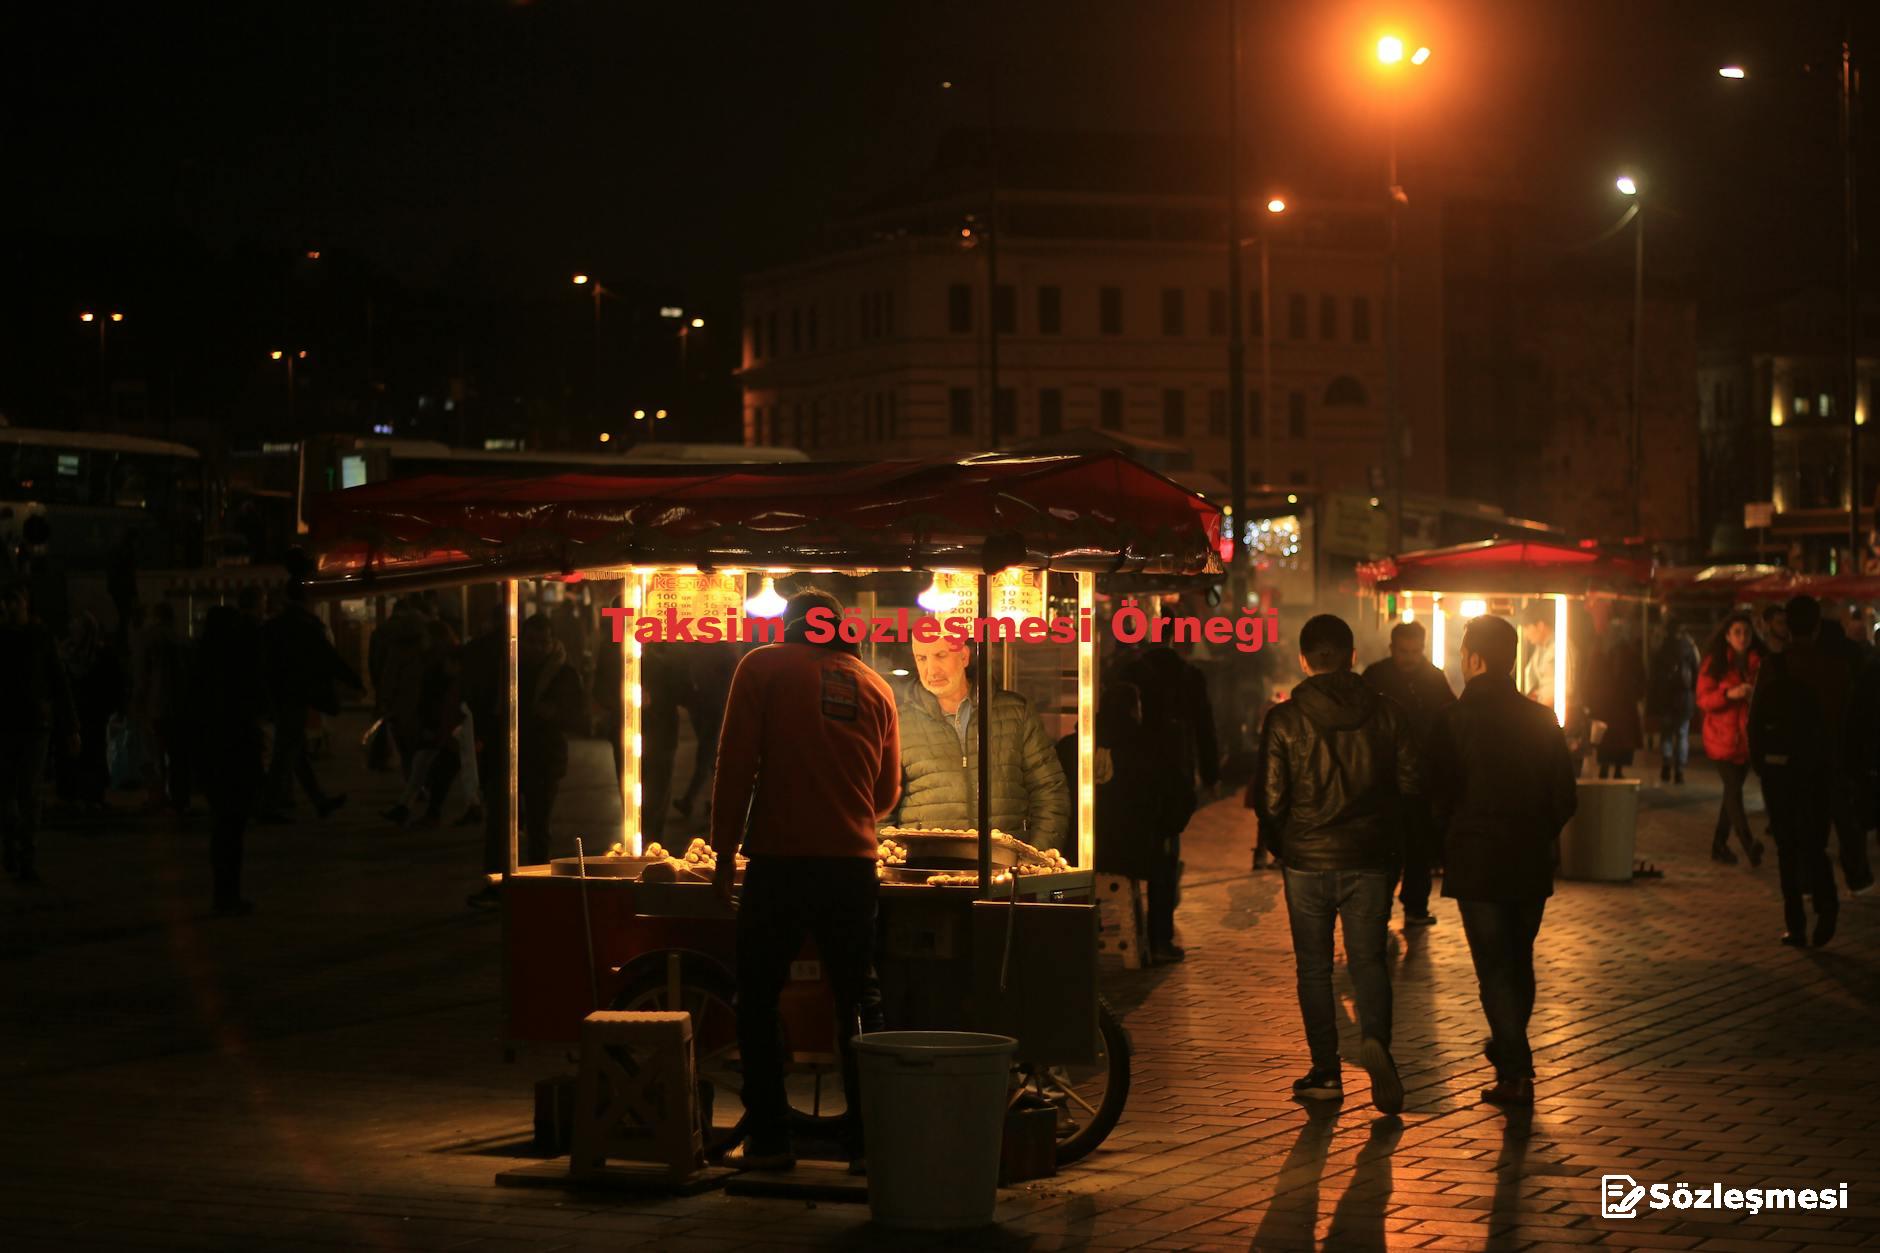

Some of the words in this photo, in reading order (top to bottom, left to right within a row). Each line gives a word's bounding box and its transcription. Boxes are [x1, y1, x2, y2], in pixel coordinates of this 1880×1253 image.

[655, 576, 734, 590] KESTANE
[656, 593, 678, 601] 100
[1000, 598, 1015, 606] 15
[950, 607, 973, 615] 200
